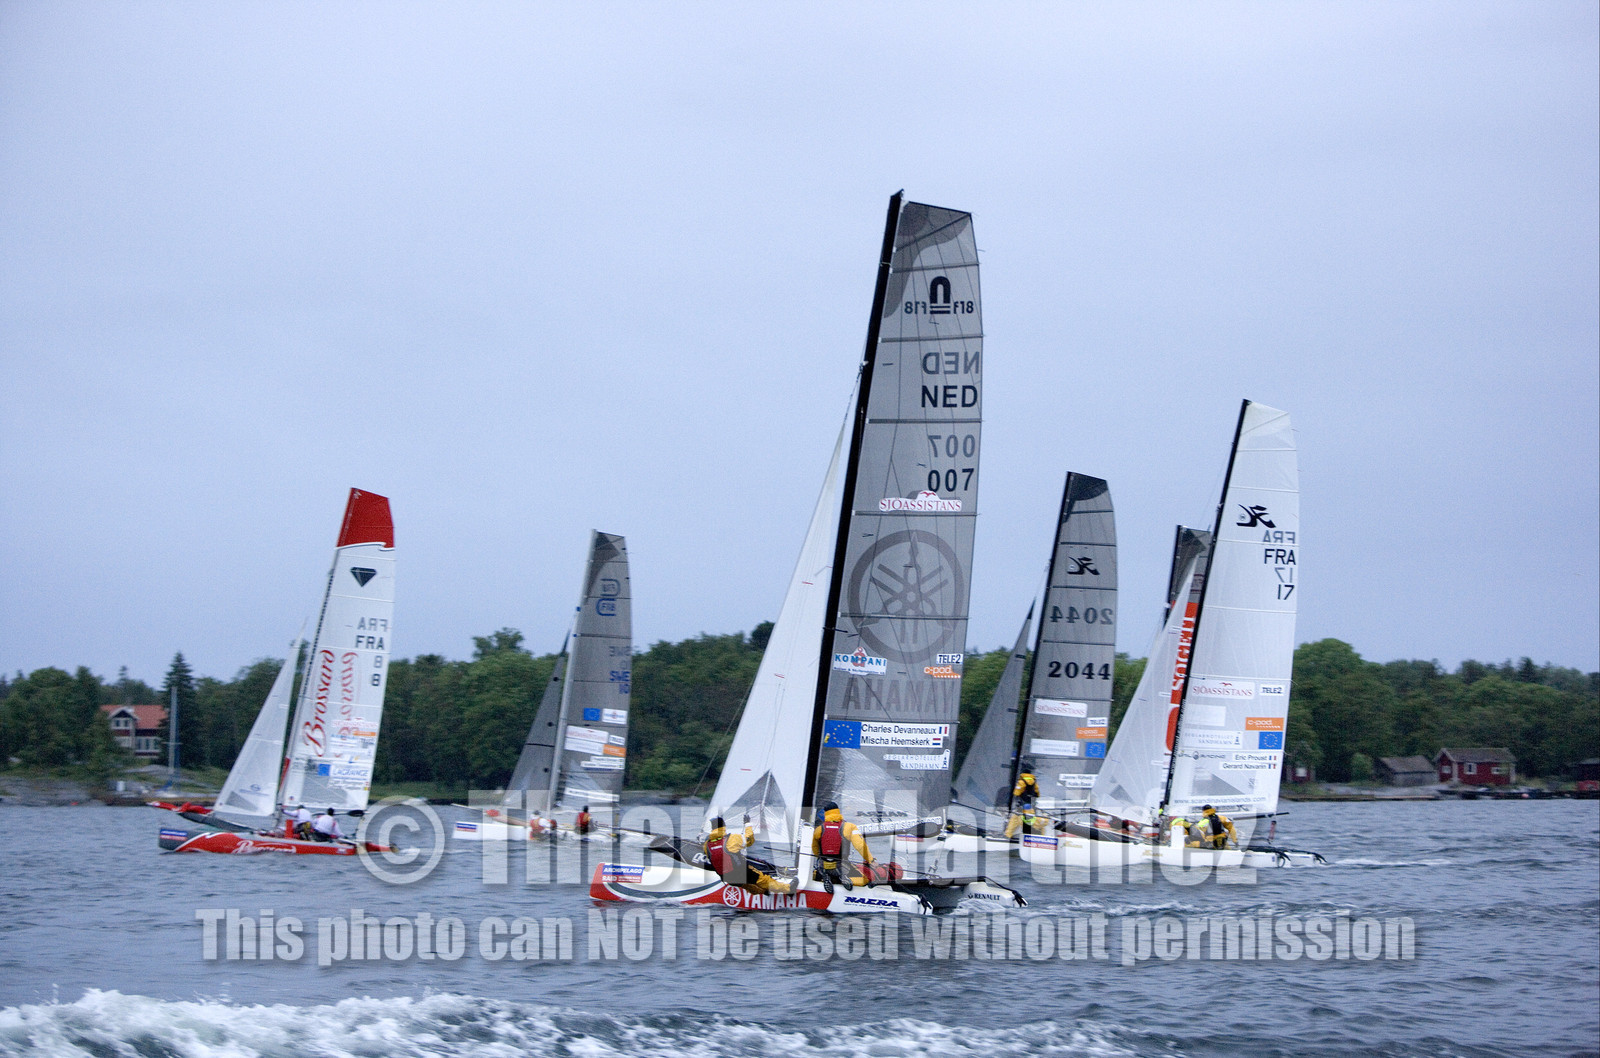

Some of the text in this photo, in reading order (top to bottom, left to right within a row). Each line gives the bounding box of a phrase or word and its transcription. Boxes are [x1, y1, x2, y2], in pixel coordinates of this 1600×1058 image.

[921, 385, 978, 408] NED
[927, 468, 975, 492] 007
[1264, 549, 1296, 565] FRA
[1277, 585, 1295, 600] 17
[355, 634, 385, 650] FRA
[835, 655, 887, 666] KOMPANI
[938, 654, 961, 664] TELE2
[1047, 660, 1112, 681] 2044
[302, 649, 336, 757] Brossard
[861, 723, 937, 735] Charles Devanneaux
[861, 735, 930, 746] Mischa Heemskerk
[743, 888, 808, 910] YAMAHA
[974, 893, 1001, 901] RENAULT
